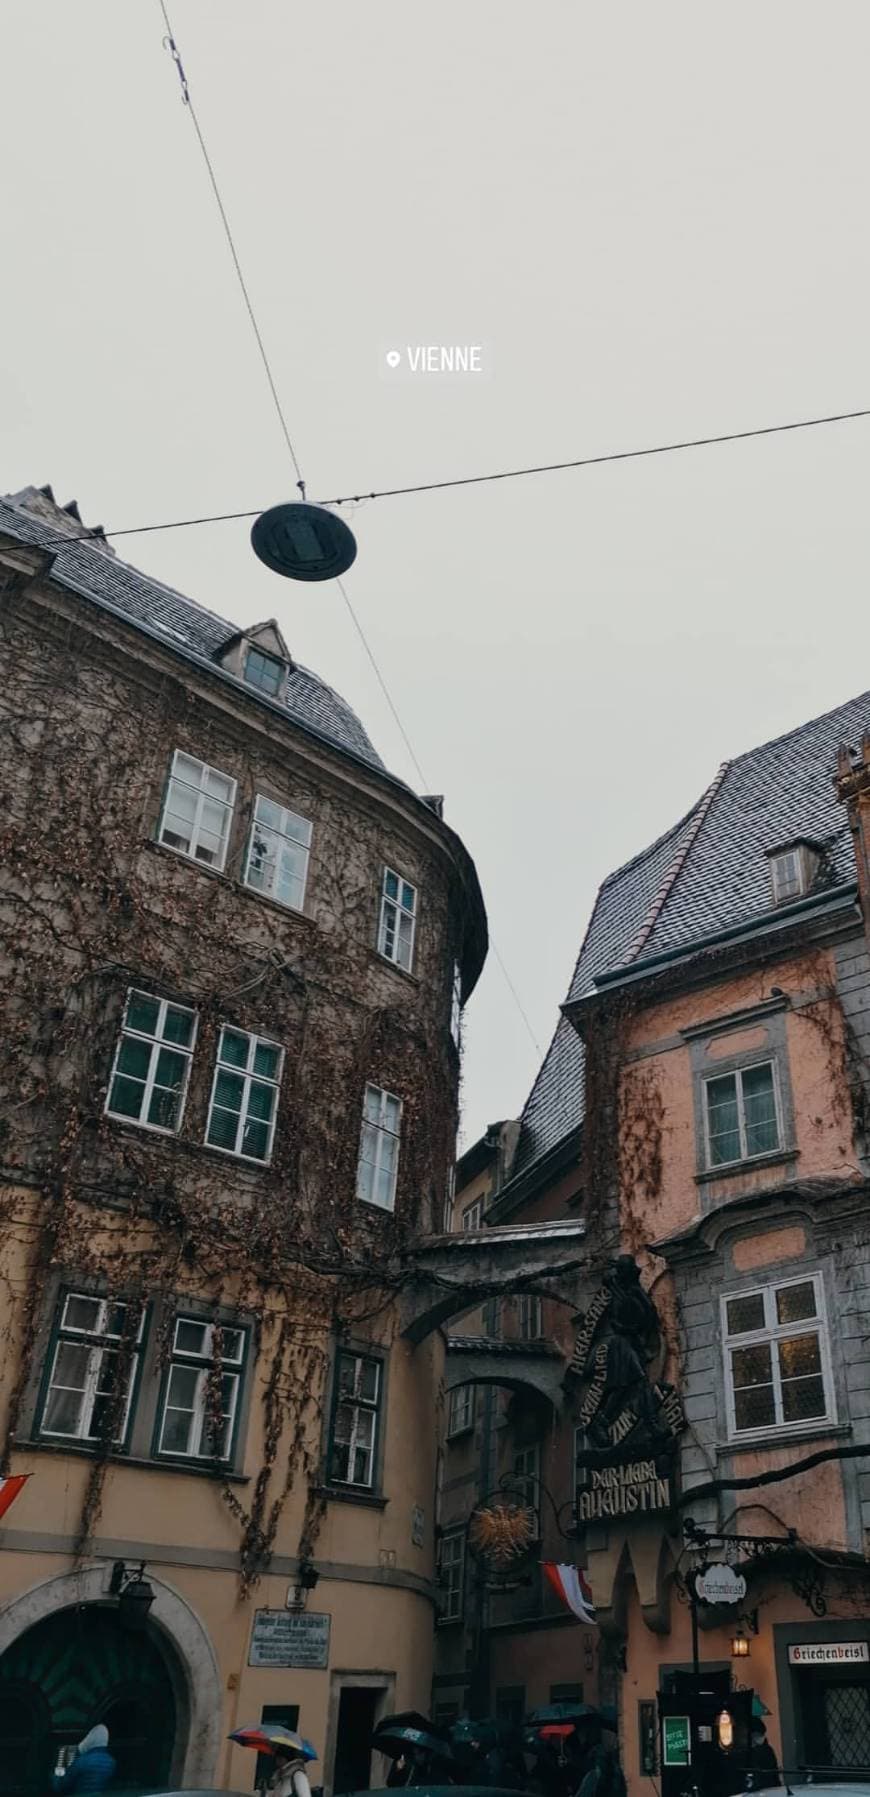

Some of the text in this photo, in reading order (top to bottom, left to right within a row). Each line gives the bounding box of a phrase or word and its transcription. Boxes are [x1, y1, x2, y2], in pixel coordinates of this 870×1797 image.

[608, 1408, 638, 1446] ZUM
[579, 1478, 671, 1520] AUGUSTIN
[794, 1646, 864, 1660] Griechenbeisl
